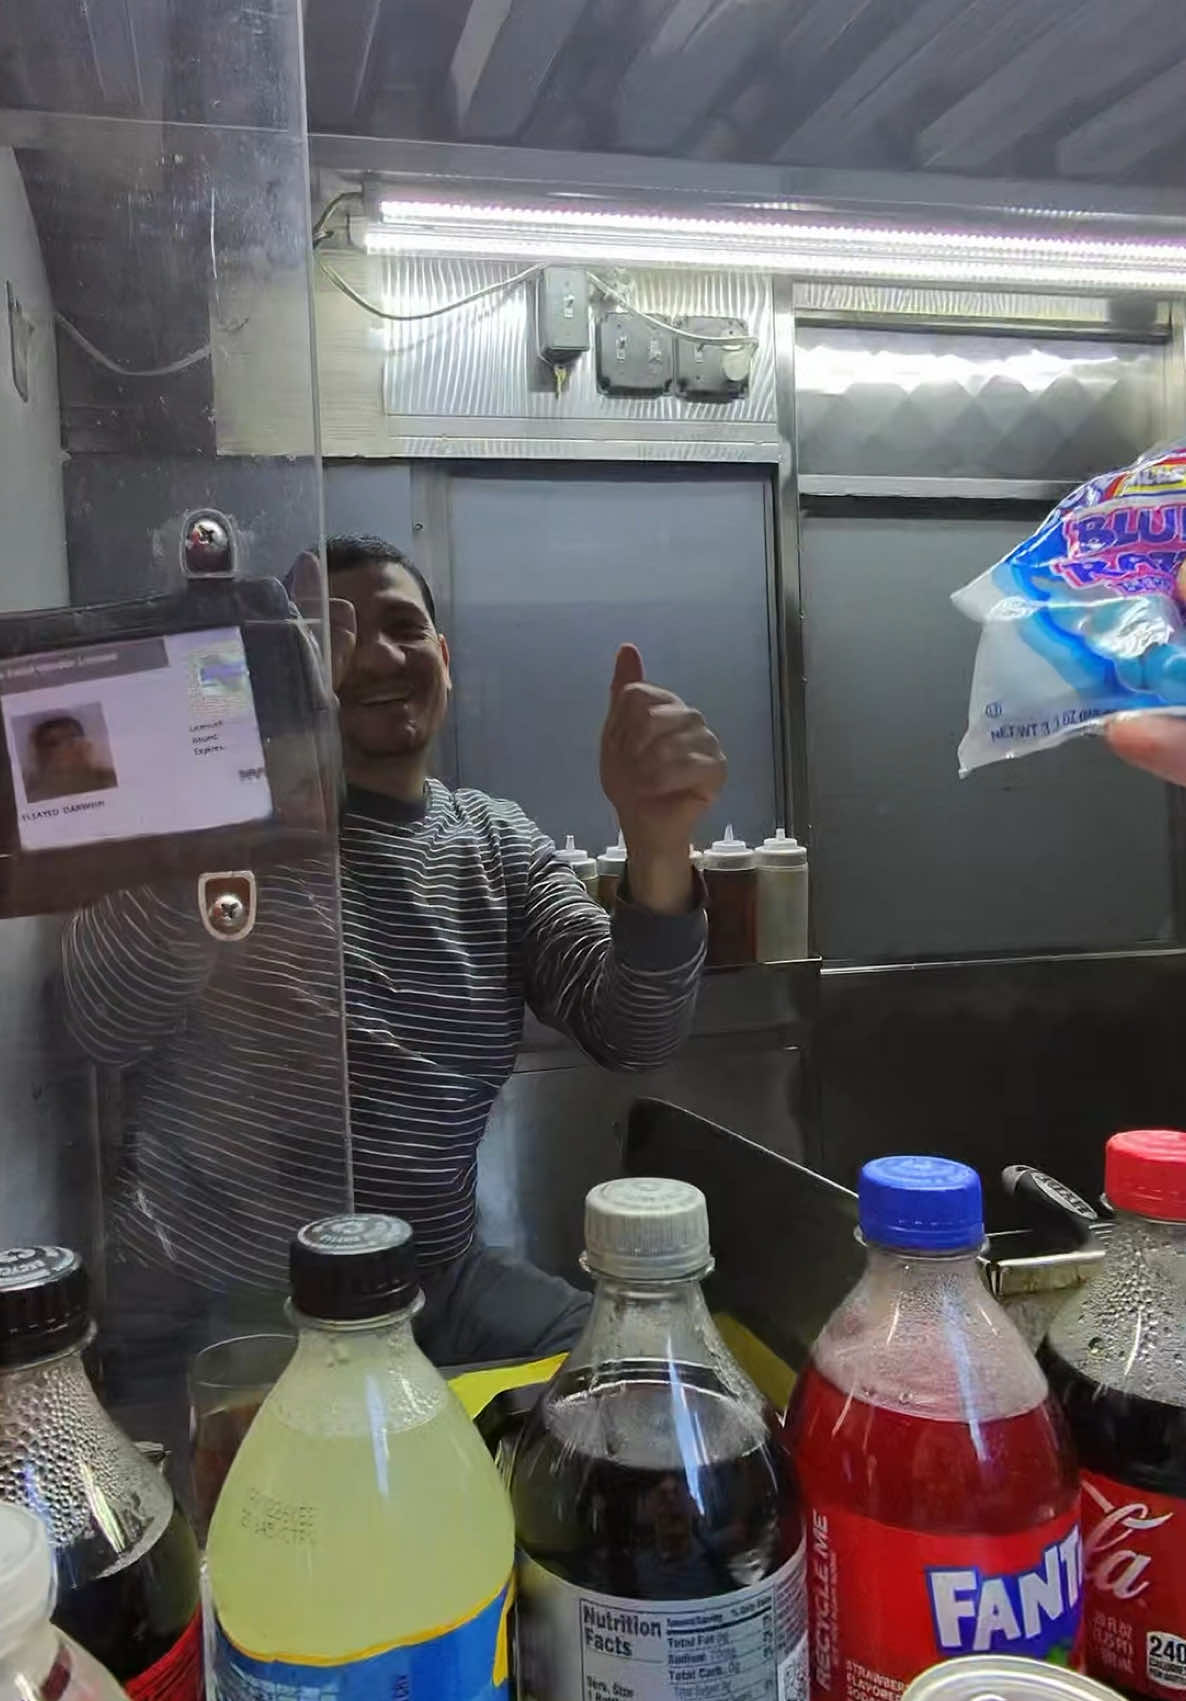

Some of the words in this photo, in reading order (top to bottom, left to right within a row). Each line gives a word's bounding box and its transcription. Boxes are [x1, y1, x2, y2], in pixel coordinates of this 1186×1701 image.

[1070, 504, 1186, 554] BLU
[812, 1507, 829, 1559] ME
[930, 1523, 1082, 1651] FANT
[583, 1605, 662, 1639] Nutrition
[584, 1627, 633, 1657] Facts
[814, 1557, 831, 1692] RECYCLE
[1148, 1634, 1186, 1665] 240
[845, 1660, 908, 1692] STRAWBER
